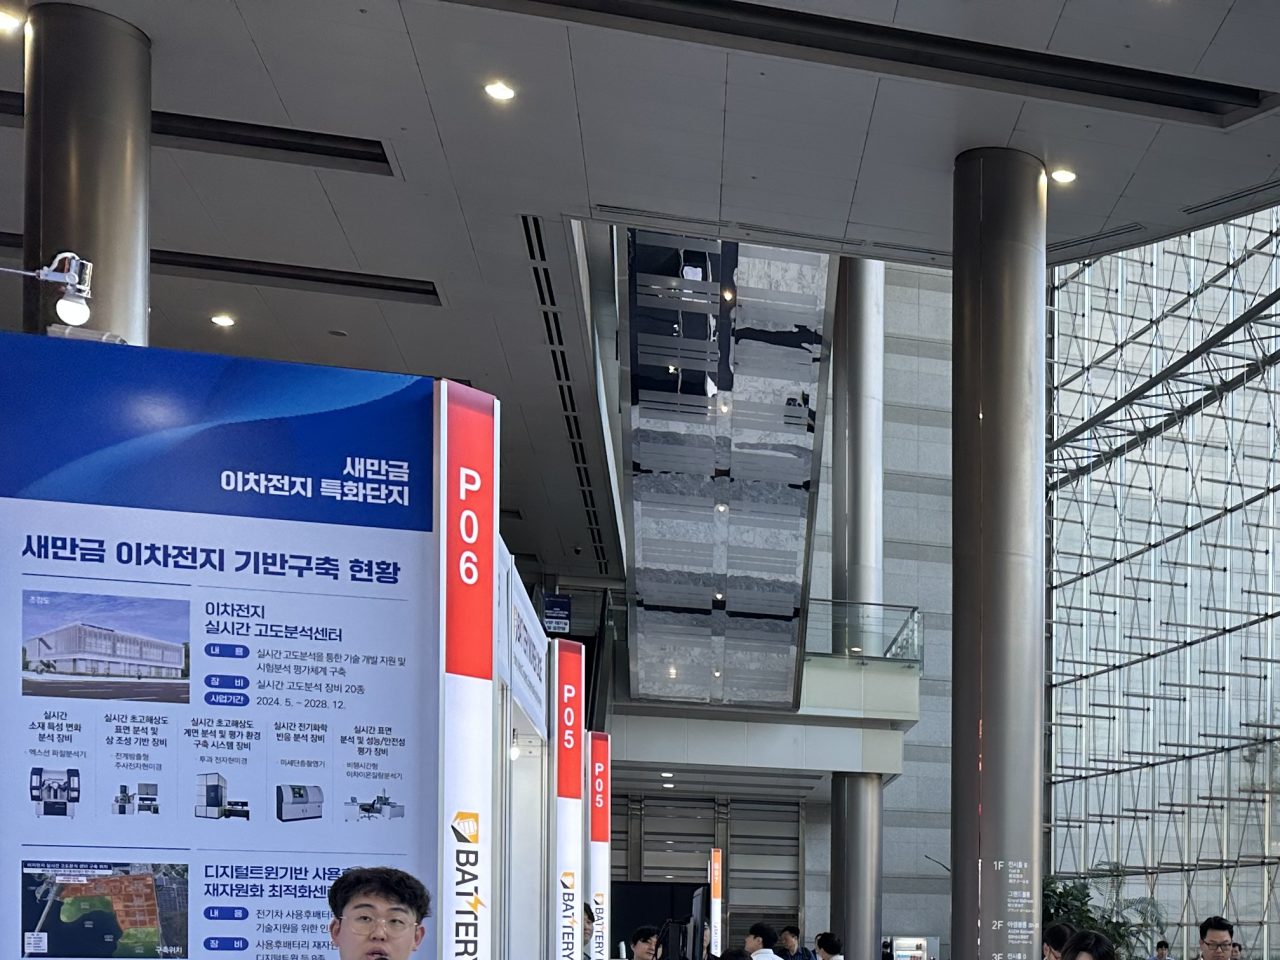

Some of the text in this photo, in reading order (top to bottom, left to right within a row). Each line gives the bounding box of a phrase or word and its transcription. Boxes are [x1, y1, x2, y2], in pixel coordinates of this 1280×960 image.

[342, 456, 409, 482] 새만금
[220, 470, 409, 506] 이차전지 특화단지
[459, 467, 482, 585] P06
[21, 534, 401, 585] 새만금 이차전지 기반구축 현황
[205, 601, 265, 619] 이차전지
[204, 620, 343, 642] 실시간 고도분석센터
[256, 648, 406, 667] 실시간 고도분석을 통한 기술 개발 지원 및
[256, 664, 347, 677] 시험분석 평가체계 구축
[256, 679, 365, 694] 실시간 고도분석 장비 20종
[210, 694, 244, 705] 사업기간
[256, 696, 281, 706] 2024.
[284, 697, 294, 707] 5.
[304, 699, 330, 709] 2028.
[332, 700, 346, 710] 12.
[43, 710, 68, 721] 실시간
[104, 713, 169, 725] 실시간 초고해상도
[563, 684, 577, 749] P05
[28, 722, 82, 733] 소재 특성 변화
[191, 717, 254, 729] 실시간 초고해상도
[274, 721, 328, 733] 실시간 전기화학
[114, 725, 159, 735] 표면 분석 및
[201, 729, 217, 738] 분석
[218, 730, 226, 739] 및
[228, 730, 244, 740] 평가
[246, 731, 261, 741] 환경
[353, 725, 392, 735] 실시간 표면
[38, 733, 73, 743] 분석 장비
[105, 736, 168, 748] 상 조성 기반 장비
[276, 733, 325, 744] 반응 분석 장비
[340, 735, 355, 744] 분석
[356, 736, 364, 745] 및
[193, 739, 251, 751] 구축 시스템 장비
[357, 747, 389, 756] 평가 장비
[594, 762, 605, 808] P05
[993, 861, 1005, 871] 1F
[204, 864, 347, 881] 디지털트윈기반 사용
[203, 883, 265, 898] 재자원화
[256, 909, 283, 920] 전기차
[256, 923, 298, 933] 기술지원을
[300, 923, 318, 934] 위한
[562, 892, 577, 960] BATTERY
[992, 920, 1004, 930] 2F
[594, 907, 605, 959] BATTERY
[155, 945, 183, 955] 구축위치
[255, 940, 310, 950] 사용후배터리
